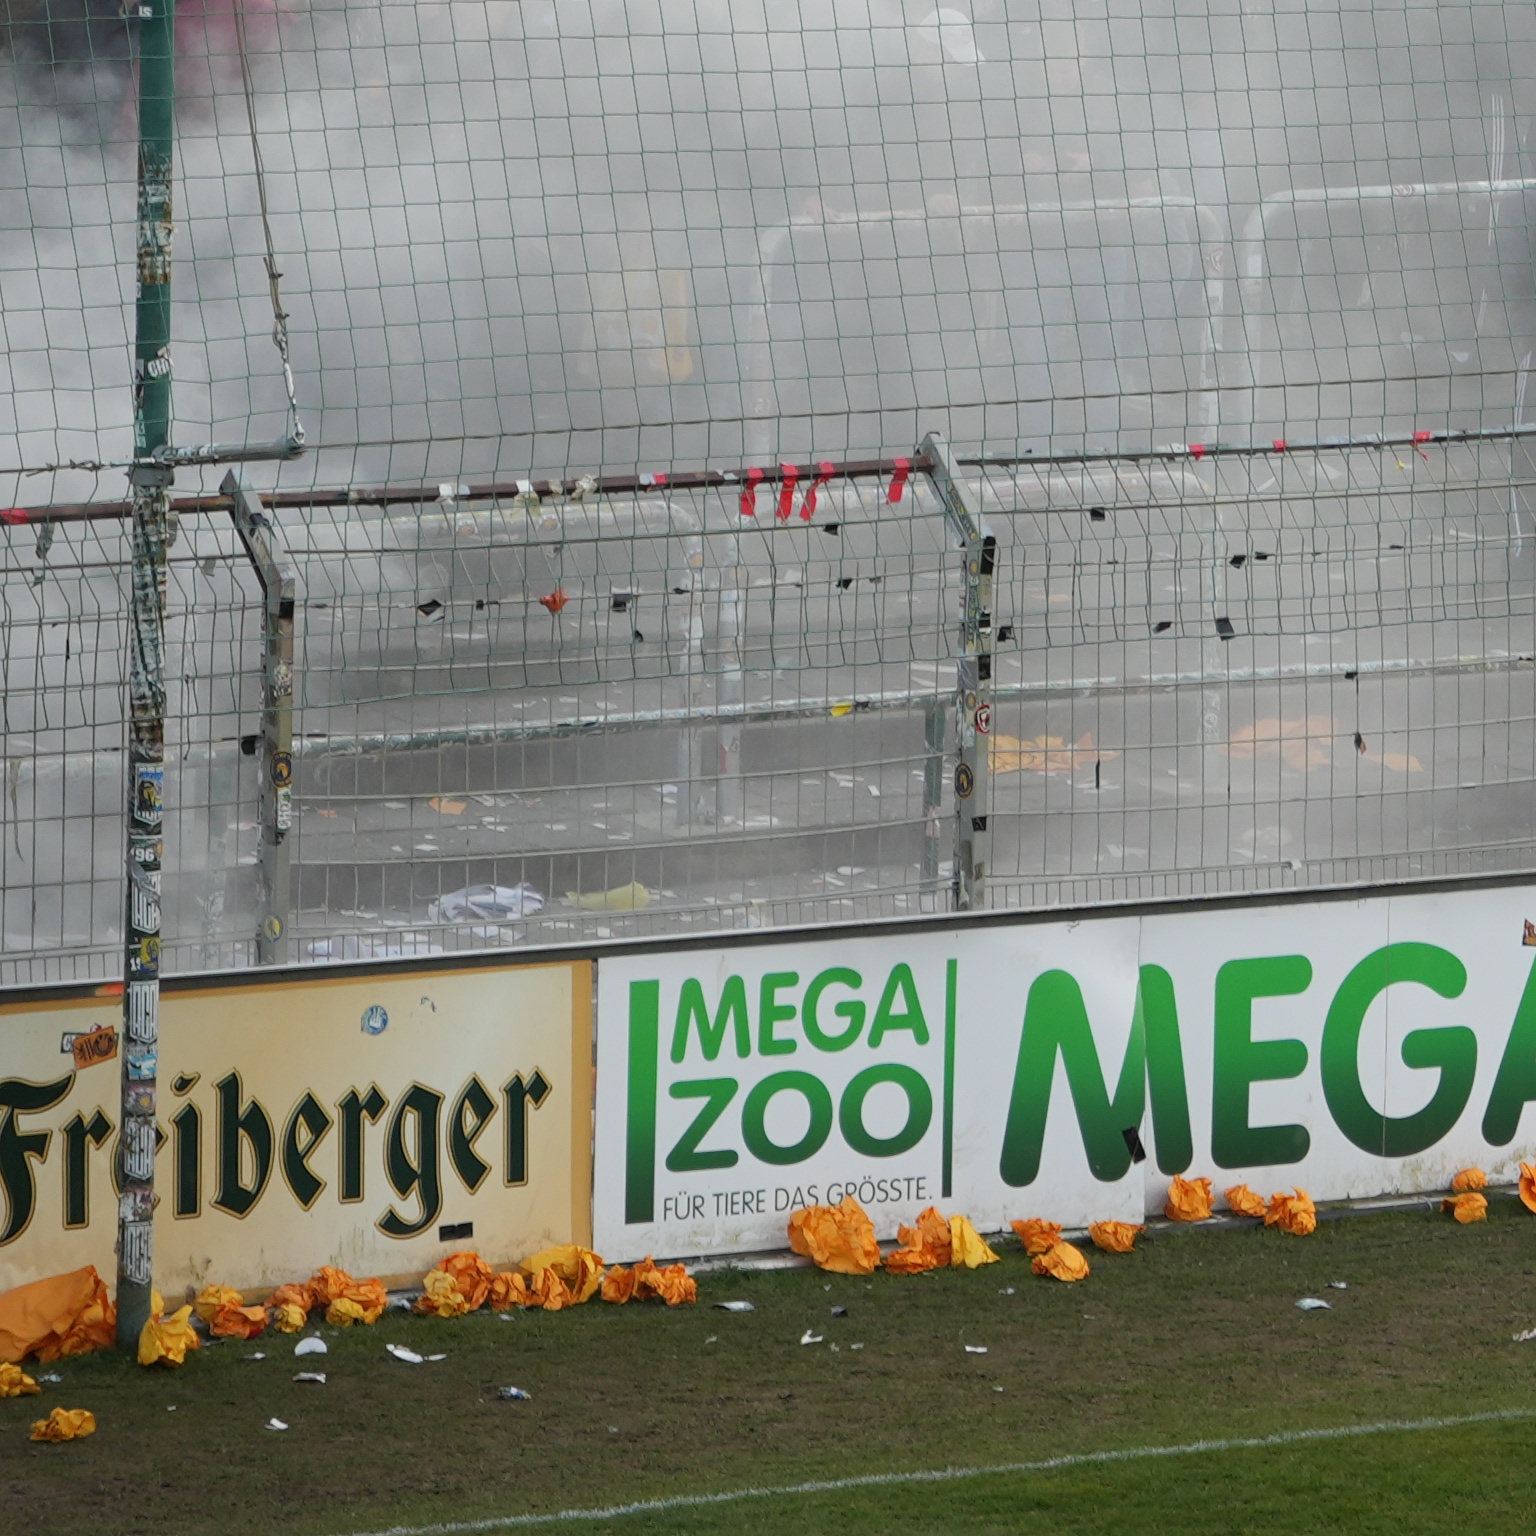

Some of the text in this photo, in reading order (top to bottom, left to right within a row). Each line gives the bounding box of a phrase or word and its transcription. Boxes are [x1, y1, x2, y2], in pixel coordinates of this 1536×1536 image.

[670, 962, 930, 1064] MEGA
[665, 1062, 933, 1172] ZOO
[663, 1176, 933, 1222] FÜR TIERE DAS GRÖSSTE.
